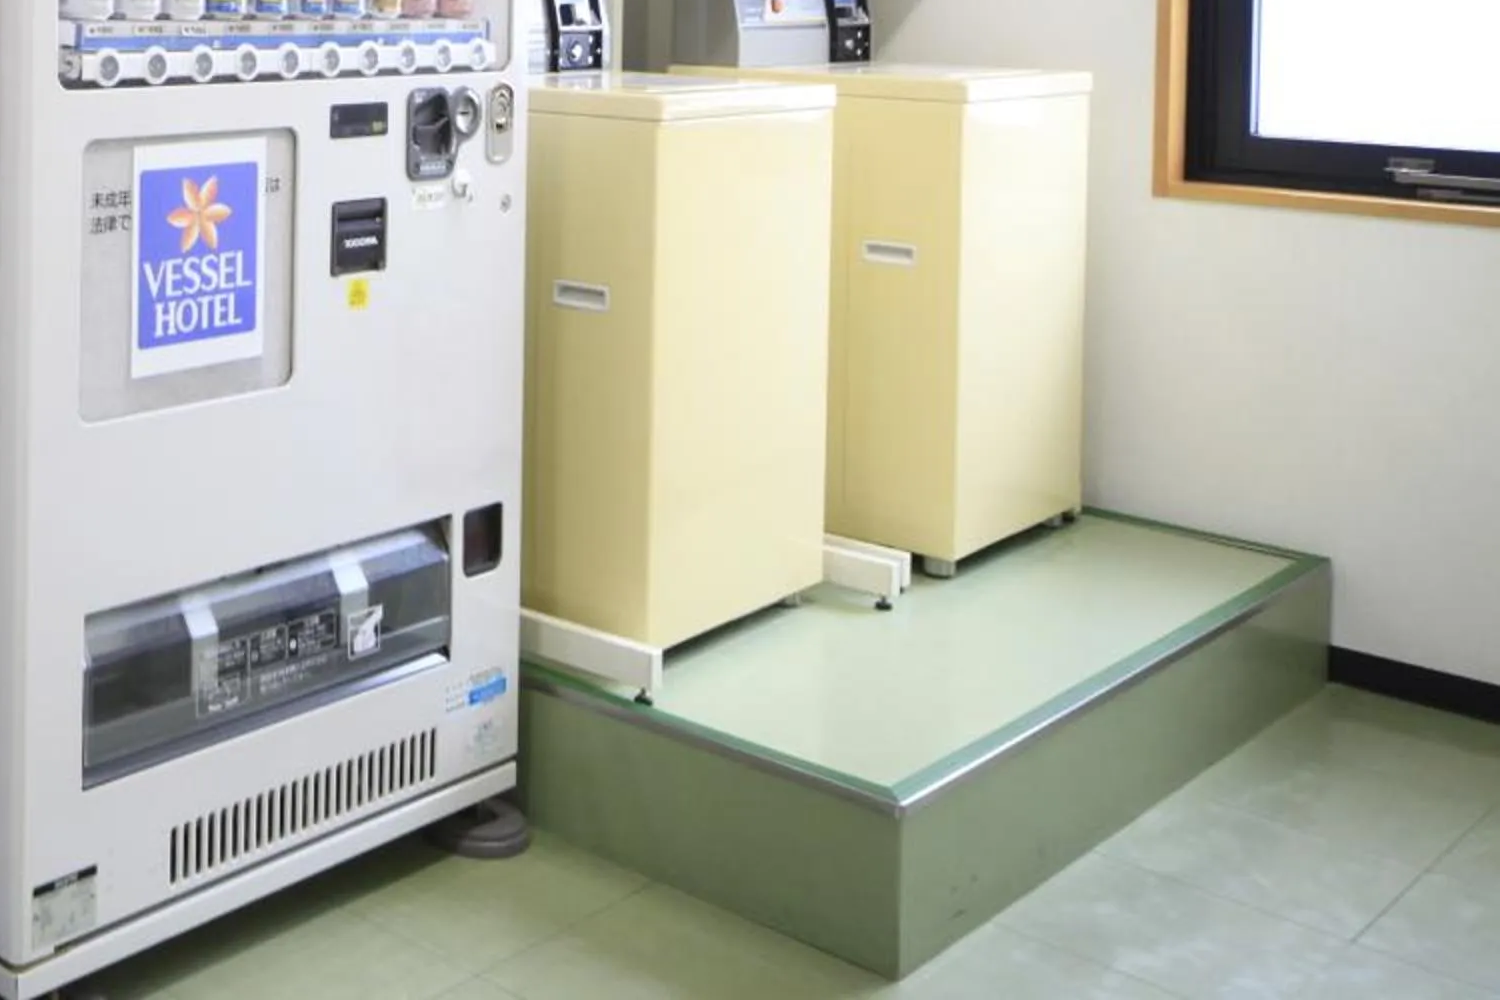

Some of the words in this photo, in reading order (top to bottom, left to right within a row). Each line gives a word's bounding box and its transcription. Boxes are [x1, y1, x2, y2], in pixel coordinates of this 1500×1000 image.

[89, 189, 133, 210] 未成年
[89, 214, 133, 235] 法律で
[142, 249, 253, 300] VESSEL
[154, 292, 243, 339] HOTEL
